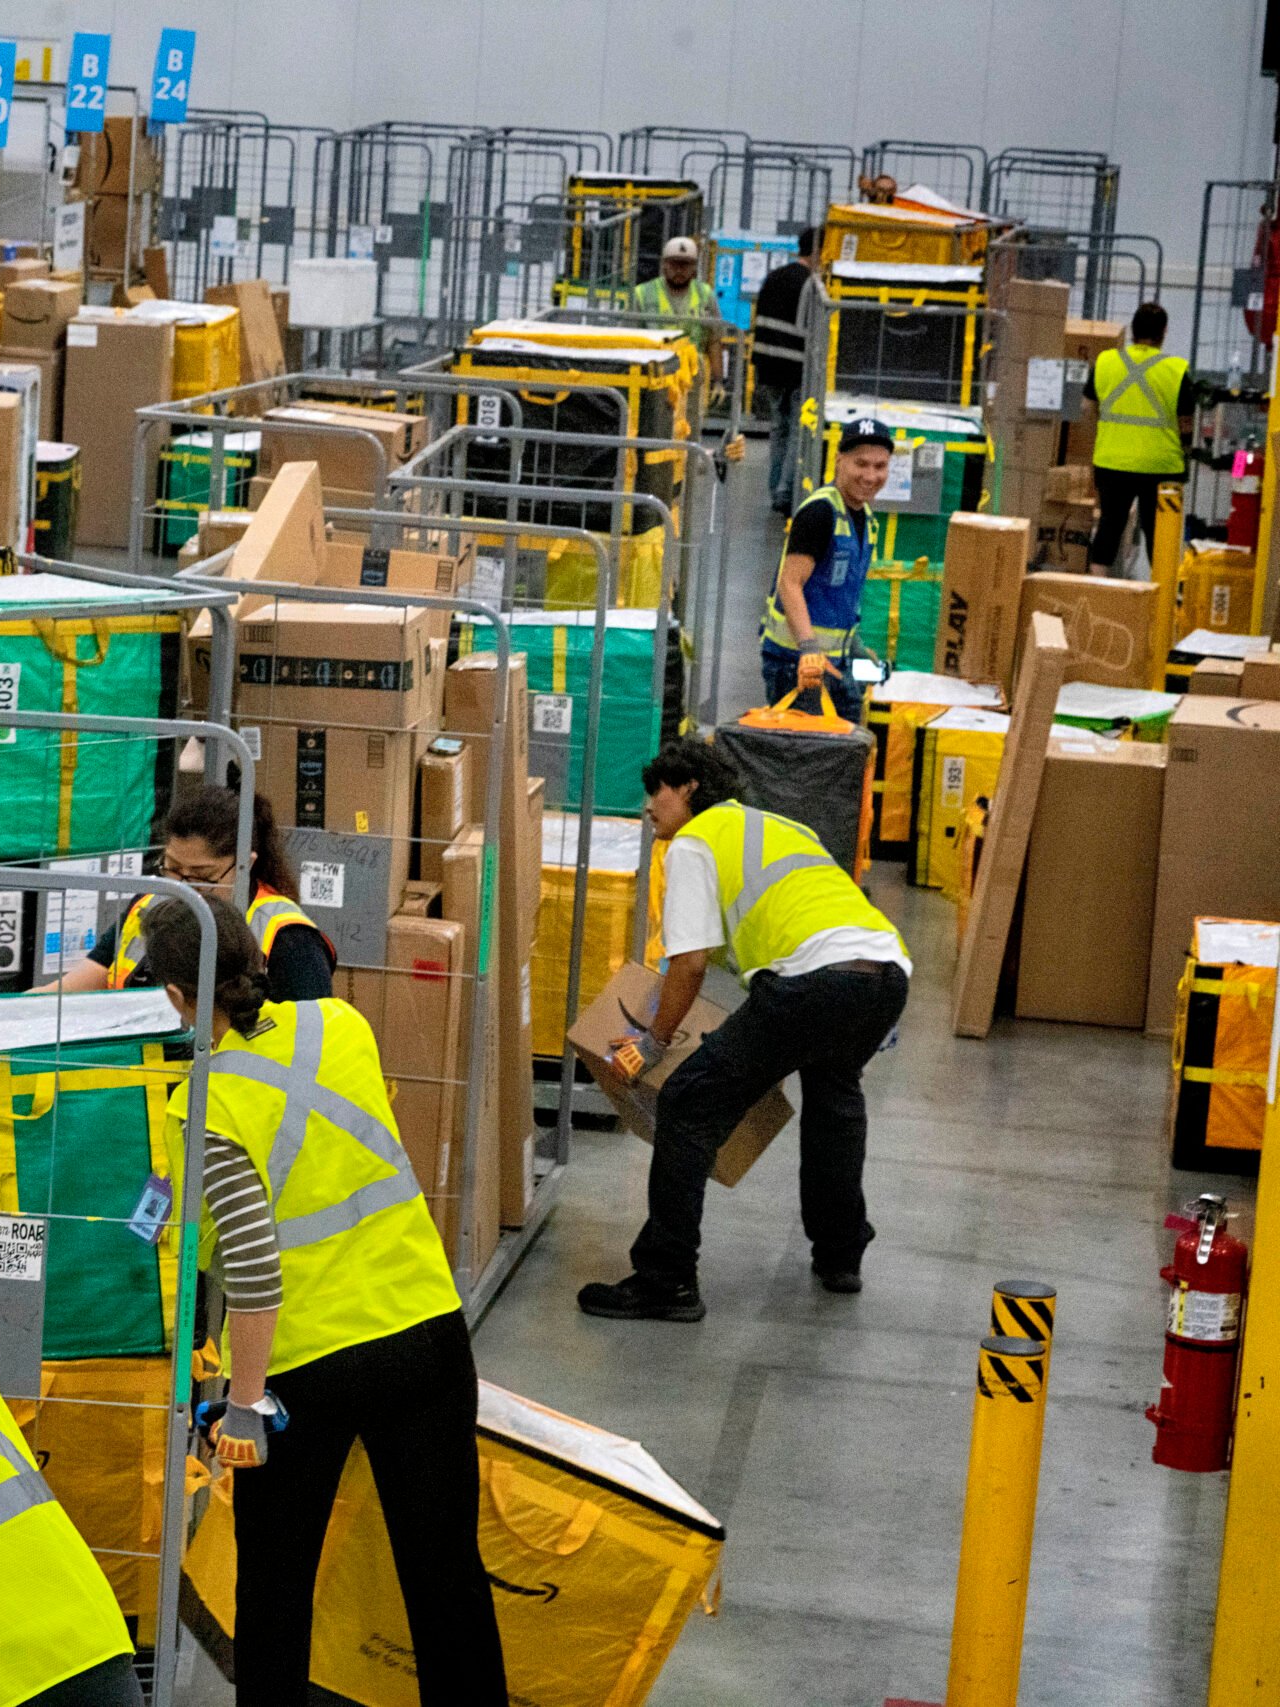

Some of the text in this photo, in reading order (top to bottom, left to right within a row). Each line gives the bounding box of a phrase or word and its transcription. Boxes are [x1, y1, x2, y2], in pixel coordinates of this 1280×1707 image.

[82, 53, 99, 78] B
[167, 49, 183, 72] B
[70, 85, 104, 111] 22
[155, 77, 187, 101] 24
[481, 400, 496, 425] 018
[948, 765, 962, 790] 193
